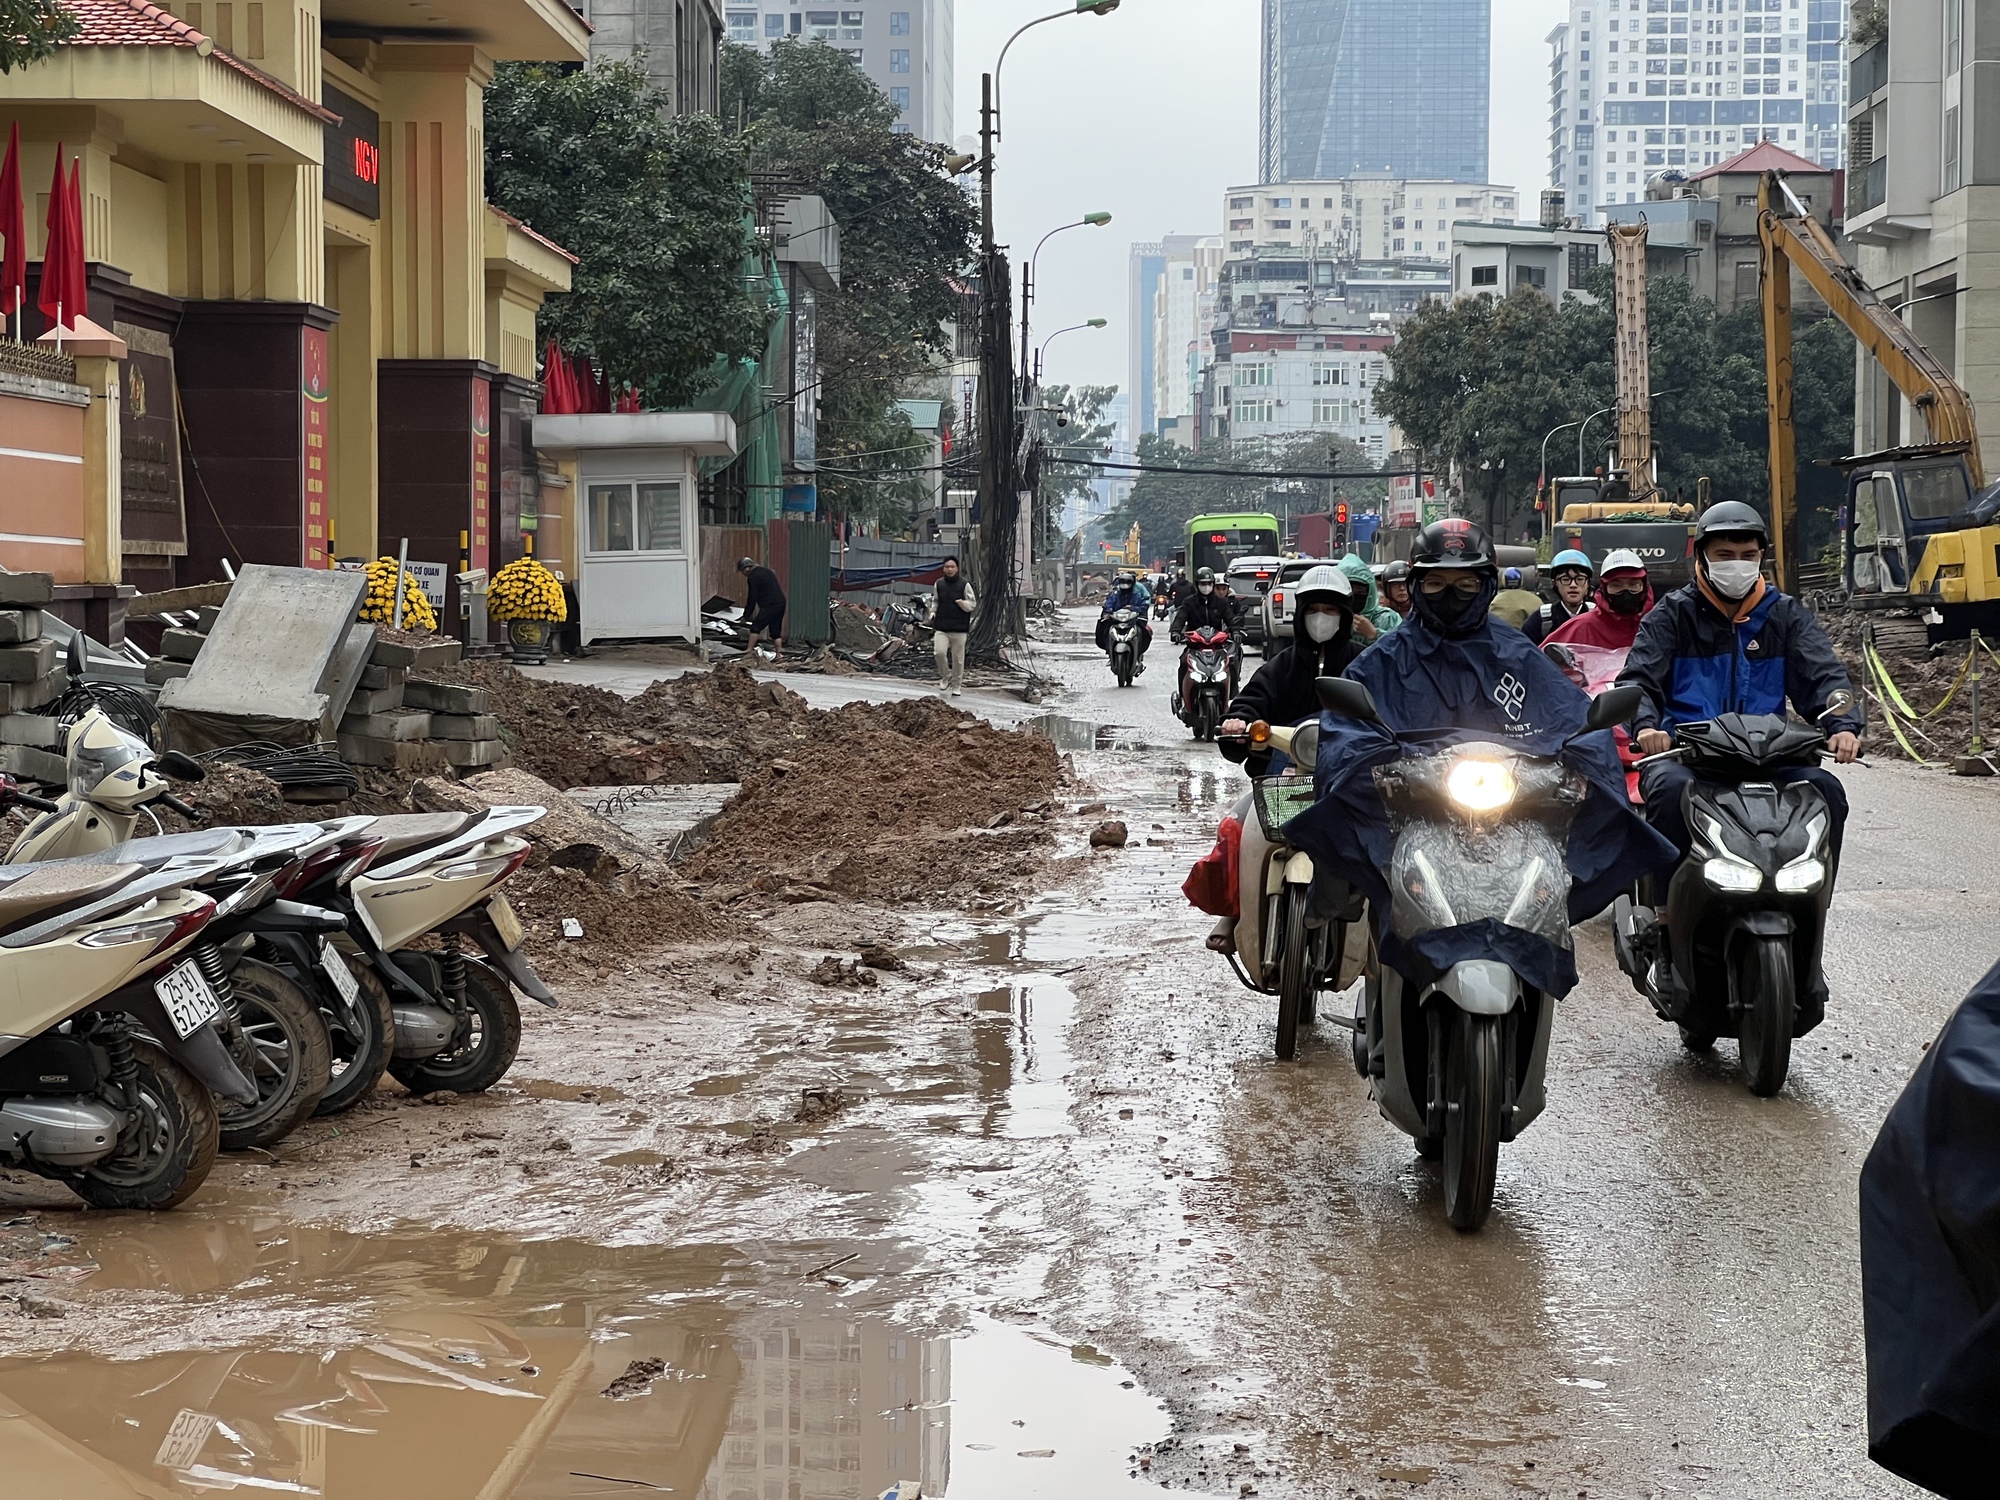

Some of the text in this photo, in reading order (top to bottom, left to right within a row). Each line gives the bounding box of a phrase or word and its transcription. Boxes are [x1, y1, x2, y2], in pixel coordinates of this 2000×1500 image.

[414, 566, 423, 575] CƠ
[424, 567, 439, 576] QUAN
[421, 581, 429, 589] XE
[435, 594, 442, 604] TỜ
[163, 966, 200, 1005] 25-B1
[173, 988, 217, 1032] 521.54
